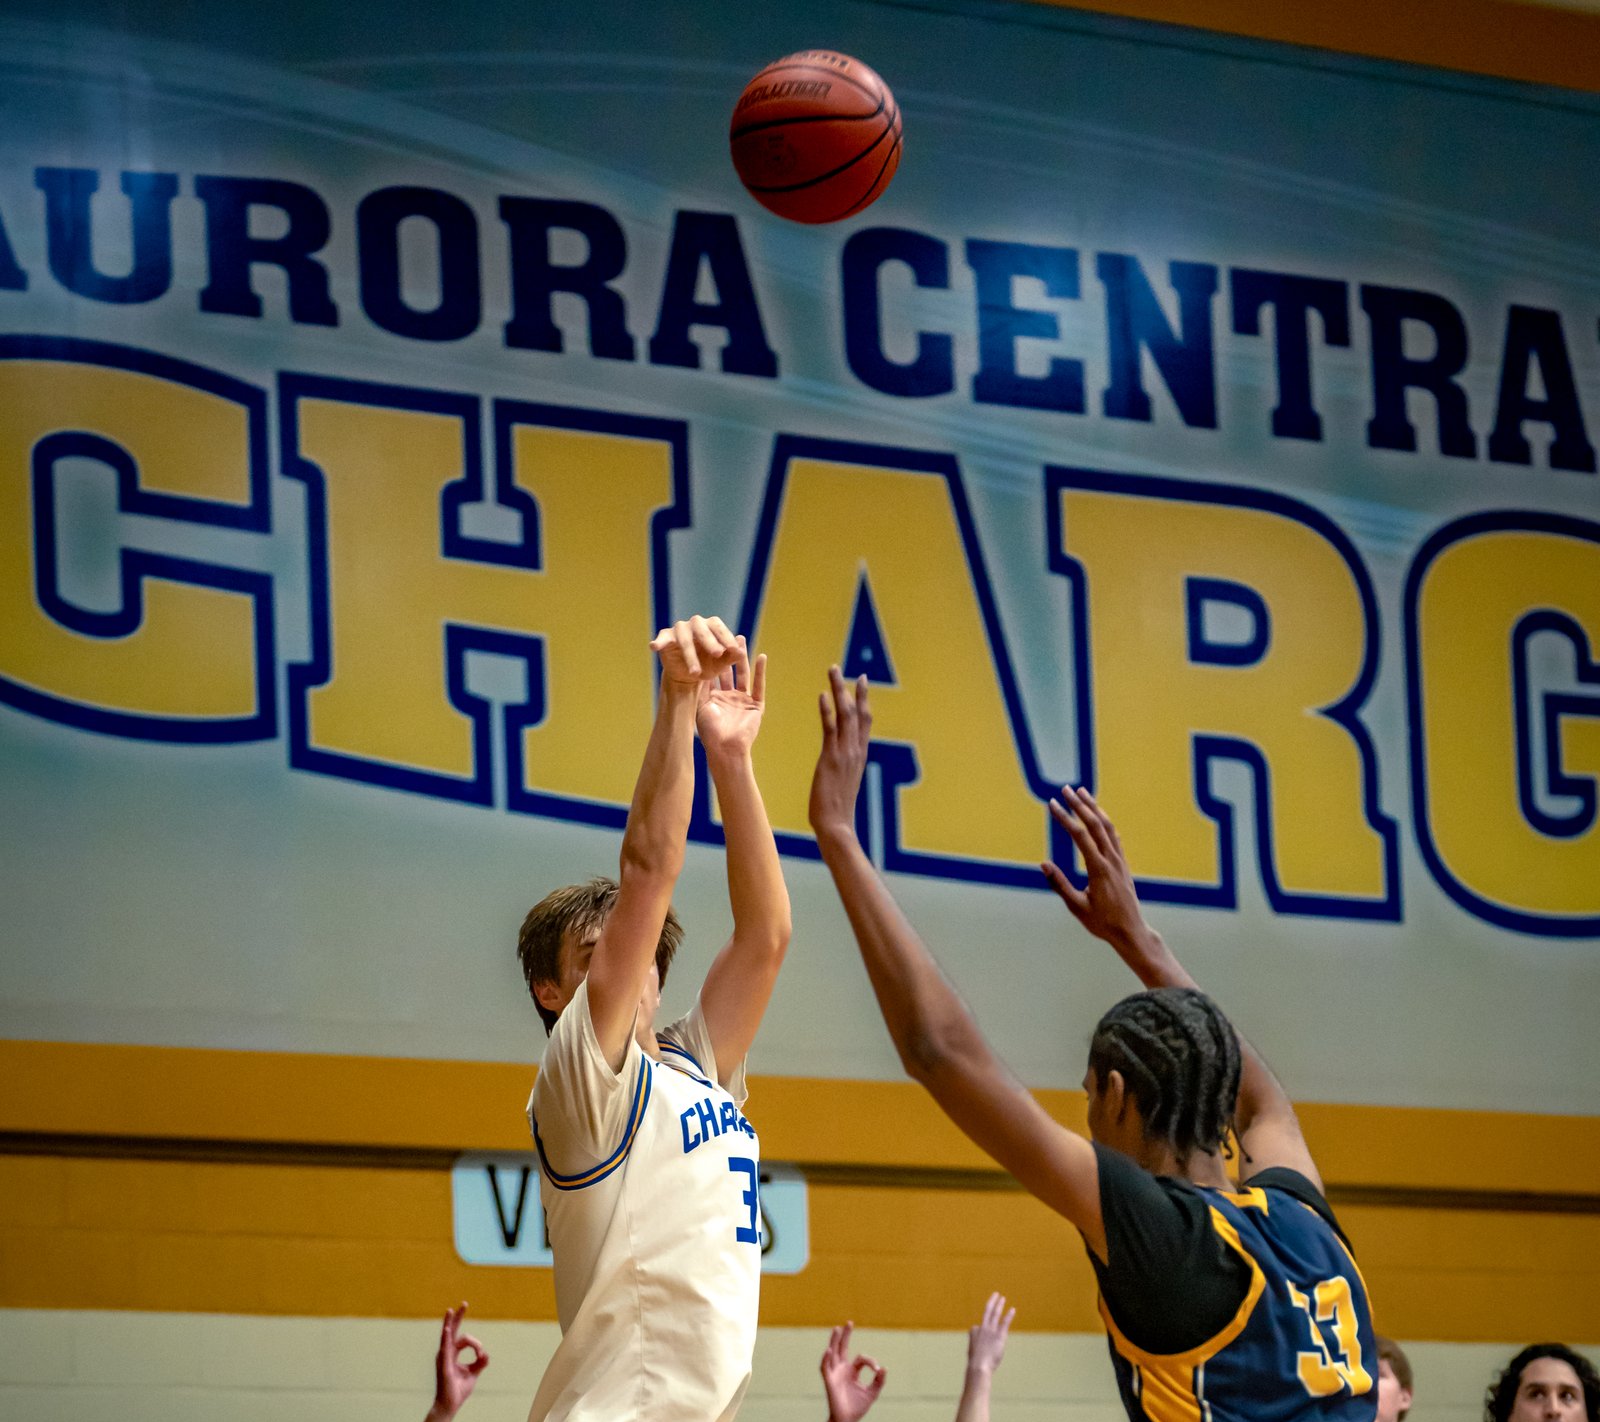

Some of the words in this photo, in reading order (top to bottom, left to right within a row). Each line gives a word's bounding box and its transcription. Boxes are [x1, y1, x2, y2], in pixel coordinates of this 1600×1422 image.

[0, 167, 780, 378] URORA
[841, 227, 1600, 474] CENTRA
[728, 1157, 761, 1246] 3
